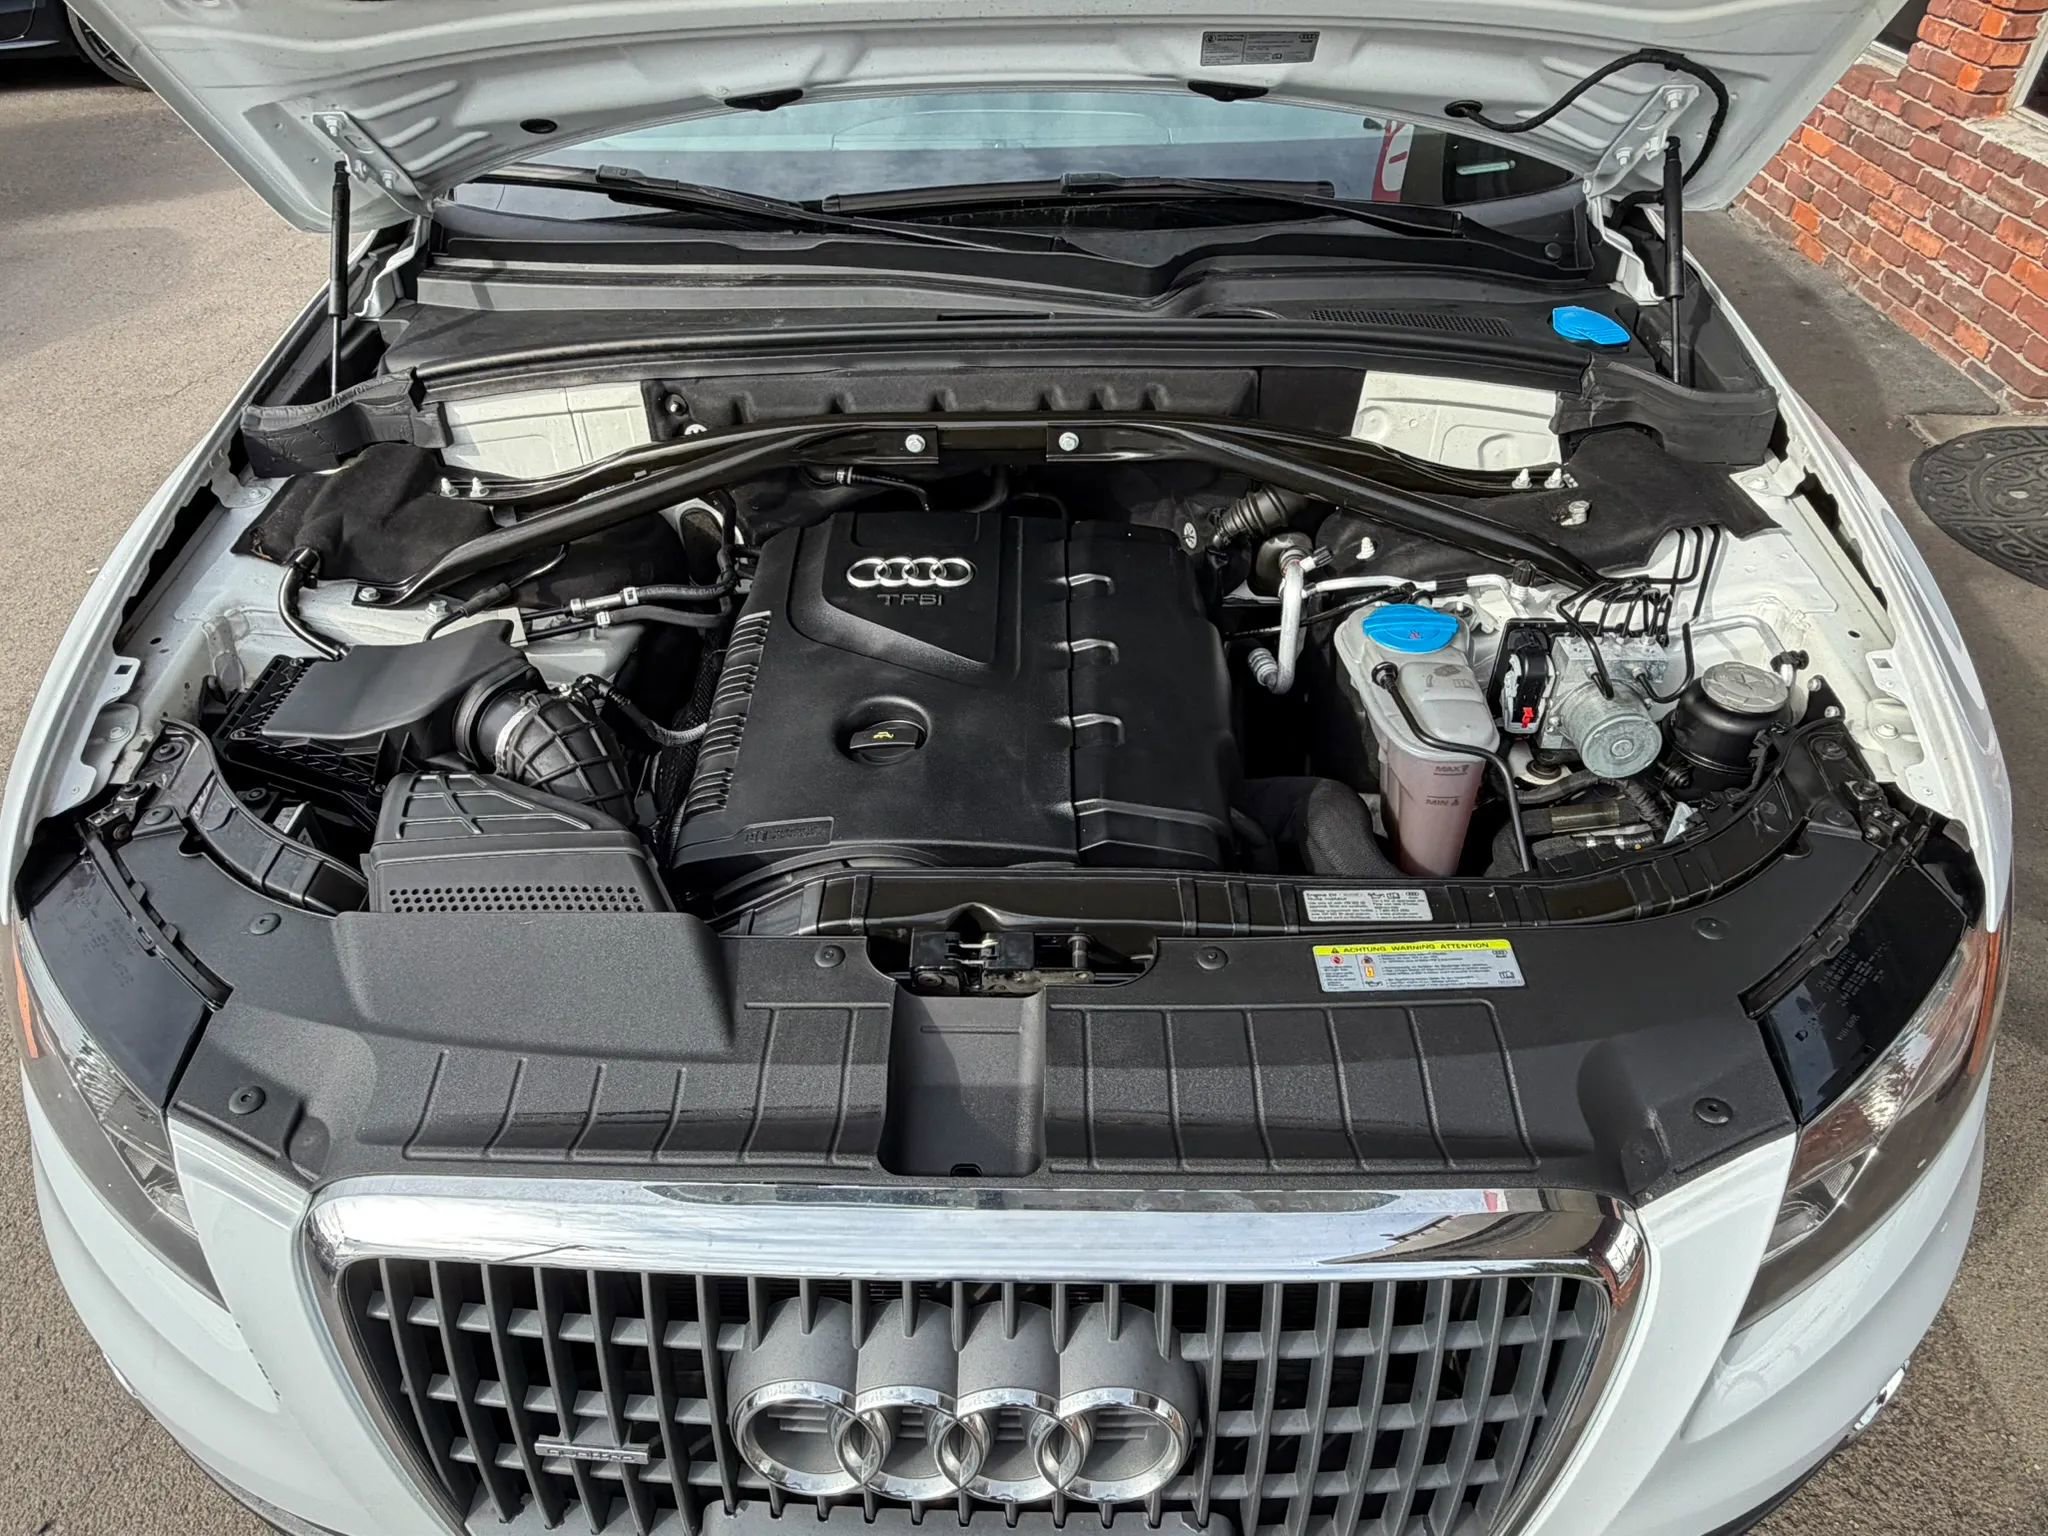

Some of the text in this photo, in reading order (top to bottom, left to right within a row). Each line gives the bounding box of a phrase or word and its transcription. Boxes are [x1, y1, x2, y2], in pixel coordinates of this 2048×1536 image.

[876, 593, 943, 607] TFSI
[1343, 941, 1489, 953] ACHTUNG WARNING ATTENTION
